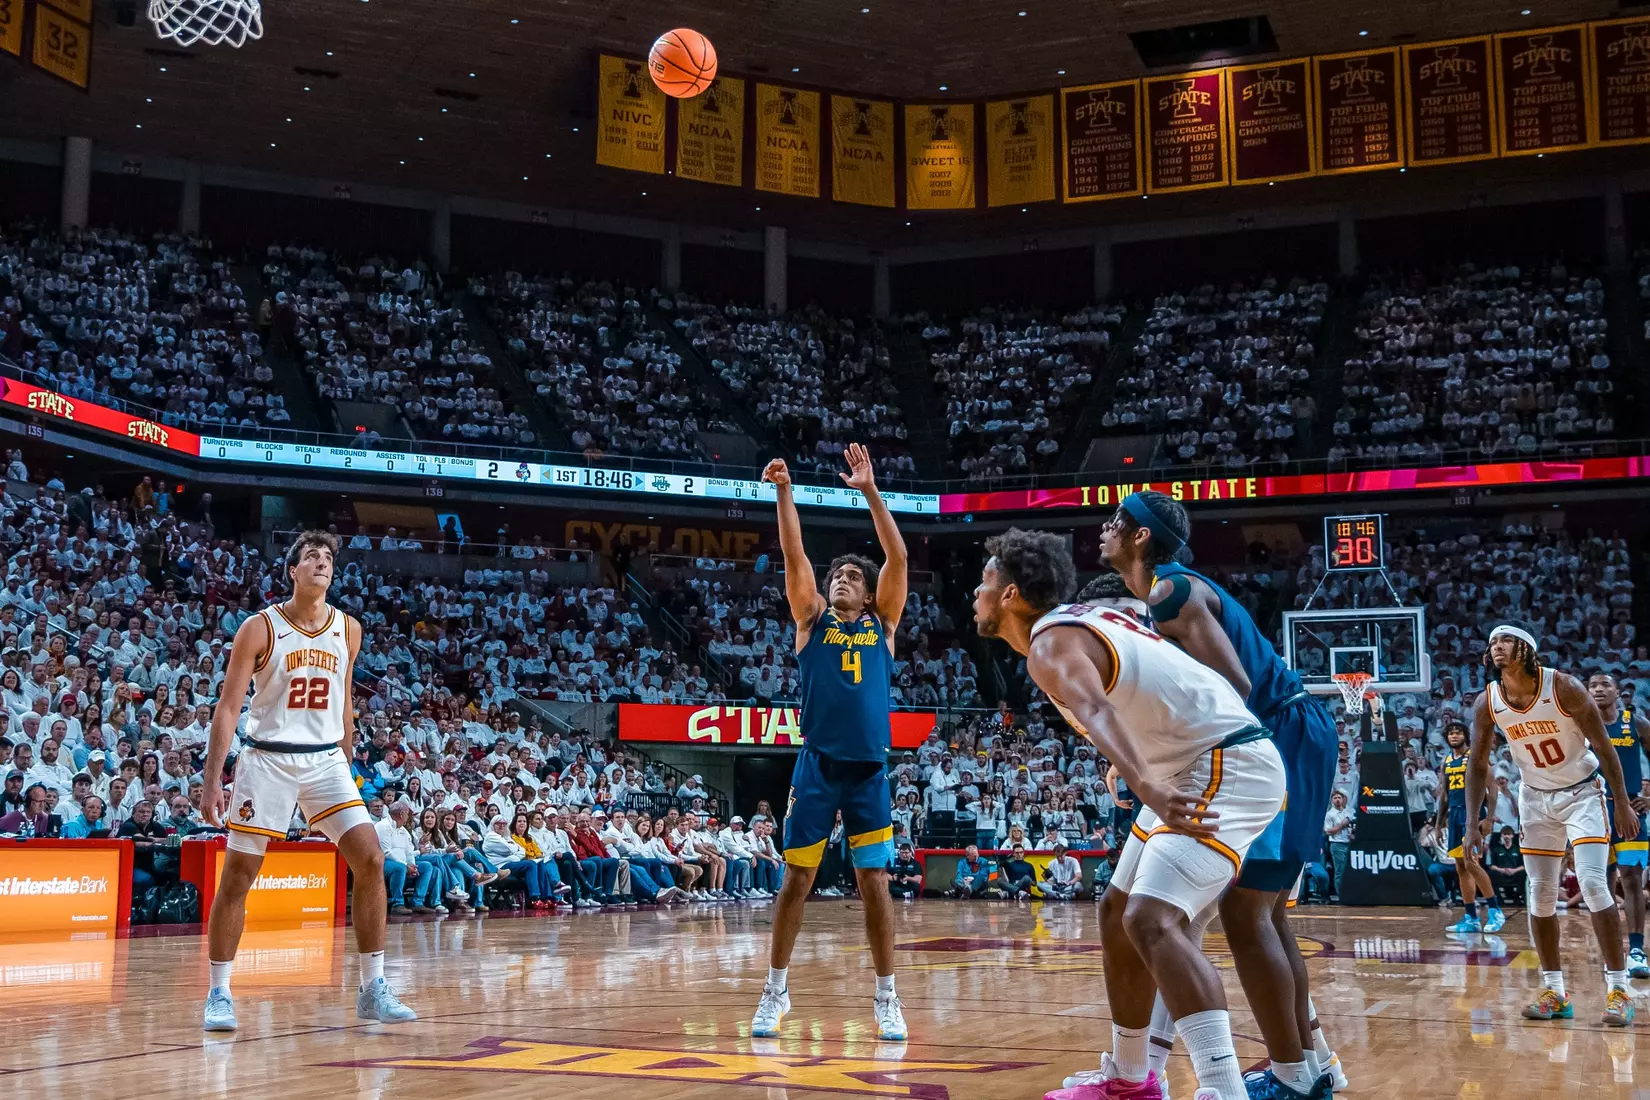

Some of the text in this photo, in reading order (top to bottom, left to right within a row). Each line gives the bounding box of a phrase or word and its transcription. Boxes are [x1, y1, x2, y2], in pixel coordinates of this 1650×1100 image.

[47, 21, 78, 59] 32
[1512, 46, 1573, 71] STATE
[1419, 58, 1477, 81] STATE
[1329, 69, 1386, 91] STATE
[1512, 85, 1538, 97] TOP
[1541, 80, 1576, 93] FOUR
[1606, 74, 1632, 86] TOP
[1242, 79, 1297, 102] STATE
[1420, 91, 1481, 107] TOP FOUR
[1513, 91, 1576, 106] FINISHES
[1158, 90, 1212, 112] STATE
[1330, 102, 1388, 117] TOP FOUR
[1420, 101, 1481, 116] FINISHES
[613, 108, 652, 126] NIVC
[1075, 99, 1126, 121] STATE
[1240, 113, 1302, 128] CONFERENCE
[1330, 112, 1389, 126] FINISHES
[688, 123, 732, 141] NCAA
[1155, 124, 1216, 137] CONFERENCE
[1239, 120, 1305, 137] CHAMPIONS
[766, 135, 809, 152] NCAA
[1072, 134, 1132, 147] CONFERENCE
[1154, 131, 1218, 146] CHAMPIONS
[1242, 137, 1269, 148] 2024
[843, 146, 885, 162] NCAA
[1071, 140, 1132, 155] CHAMPIONS
[1190, 143, 1215, 153] 1979
[911, 156, 970, 166] SWEET 16
[1190, 153, 1215, 163] 1982
[928, 170, 952, 178] 2007
[1074, 166, 1098, 175] 1941
[1190, 163, 1214, 173] 2007
[1075, 175, 1099, 185] 1947
[28, 391, 74, 420] STATE
[28, 425, 42, 437] 135
[127, 420, 169, 447] STATE
[203, 438, 244, 448] TURNOVERS
[255, 443, 284, 451] BLOCKS
[295, 446, 321, 454] STEALS
[330, 449, 367, 457] REBOUNDS
[375, 452, 405, 461] ASSISTS
[416, 455, 428, 463] TOL
[450, 458, 474, 466] BONUS
[218, 447, 443, 474] 0 0 0 2 0 4 1
[487, 462, 499, 479] 2
[556, 469, 633, 489] 1ST 18:46
[425, 487, 443, 497] 138
[683, 477, 694, 493] 2
[708, 479, 729, 487] BONUS
[733, 480, 744, 488] FLS
[804, 486, 835, 495] REBOUNDS
[844, 489, 864, 497] STEALS
[903, 494, 937, 502] TURNOVERS
[1172, 478, 1257, 501] STATE
[735, 487, 923, 512] 0 4 0 0 0
[727, 509, 744, 519] 139
[1337, 521, 1376, 537] 18 46
[565, 520, 760, 559] CYCLONE
[1338, 537, 1373, 565] 30
[822, 627, 879, 649] Marquette
[285, 648, 339, 673] IOWA STATE
[841, 650, 863, 684] 4
[287, 676, 331, 710] 22
[688, 706, 806, 745] STA
[1506, 720, 1560, 741] IOWA STATE
[1524, 738, 1565, 769] 10
[1448, 774, 1465, 790] 23
[9, 875, 109, 896] Interstate Bank
[257, 874, 307, 890] Interstate
[307, 874, 329, 889] Bank
[71, 914, 109, 922] firstinterstate.com
